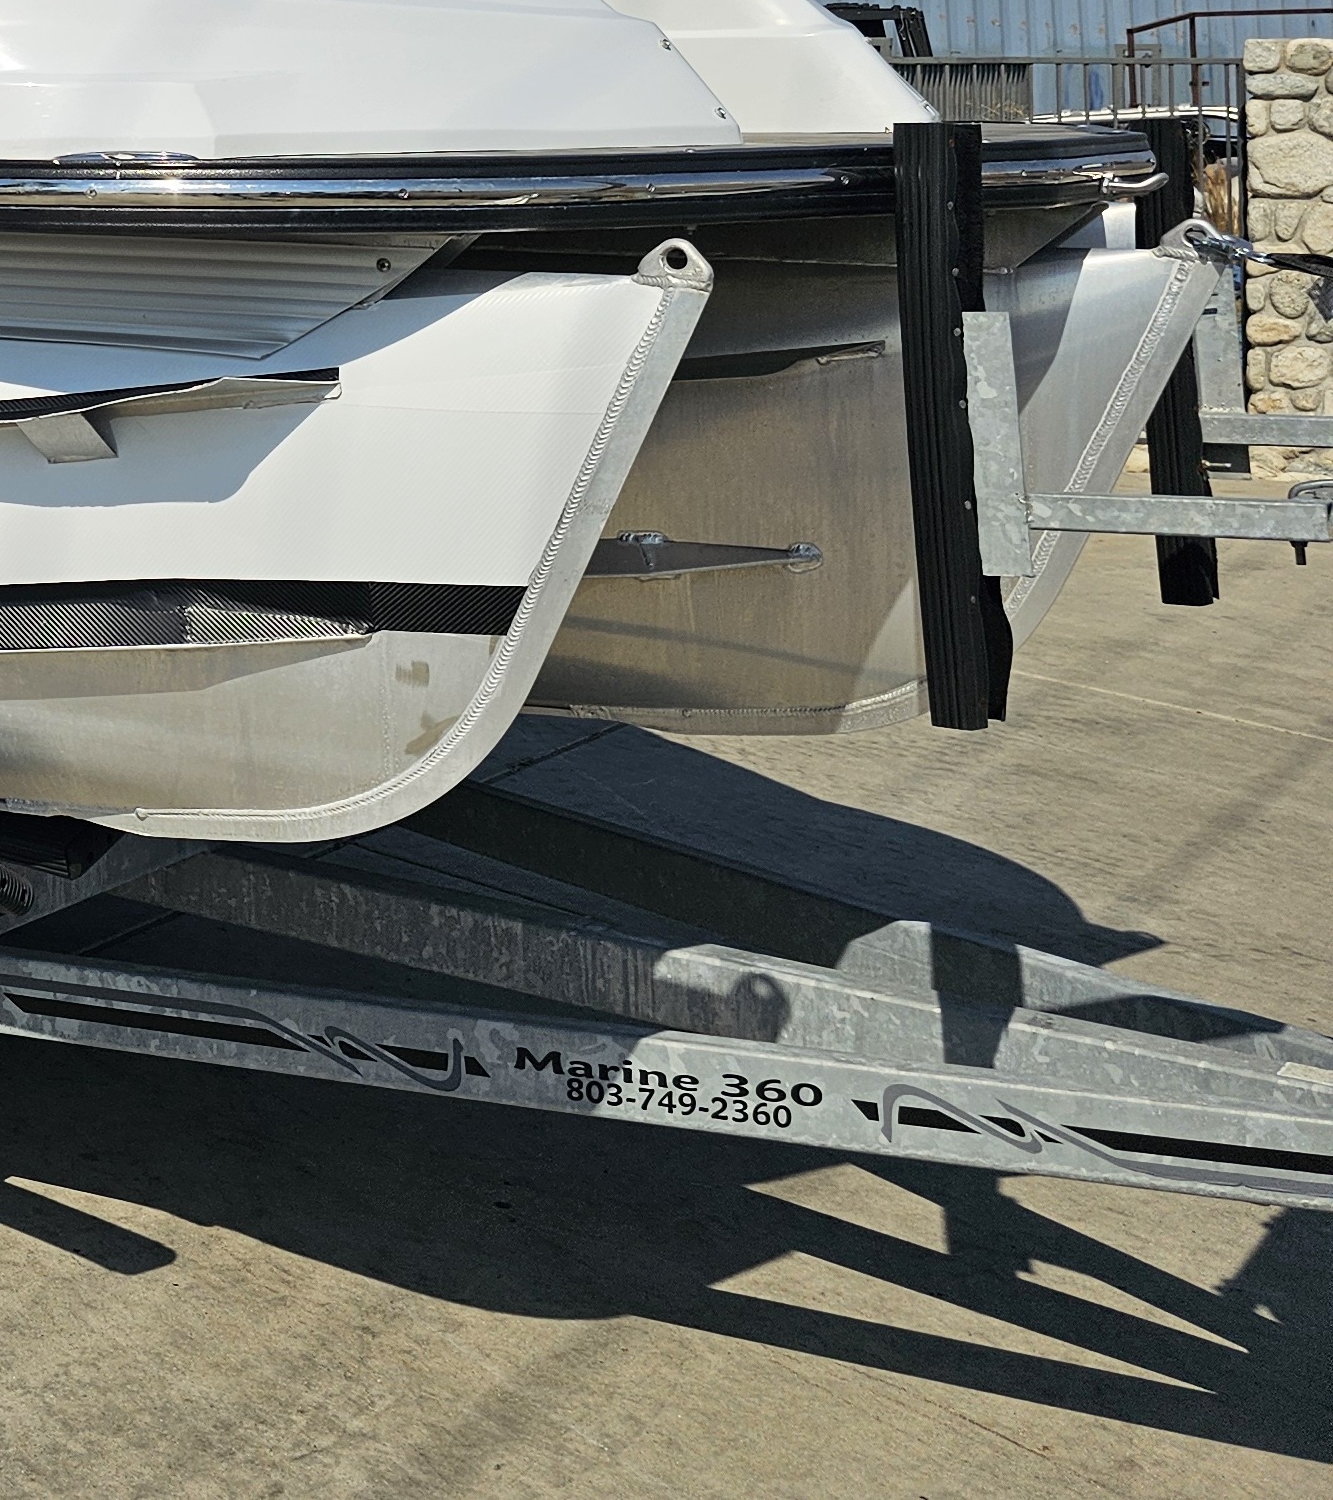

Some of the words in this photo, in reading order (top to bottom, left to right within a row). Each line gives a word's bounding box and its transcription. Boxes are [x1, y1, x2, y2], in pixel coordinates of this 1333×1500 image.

[513, 1046, 701, 1093] Marine
[719, 1073, 824, 1107] 360
[566, 1077, 793, 1129] 803-749-2360
